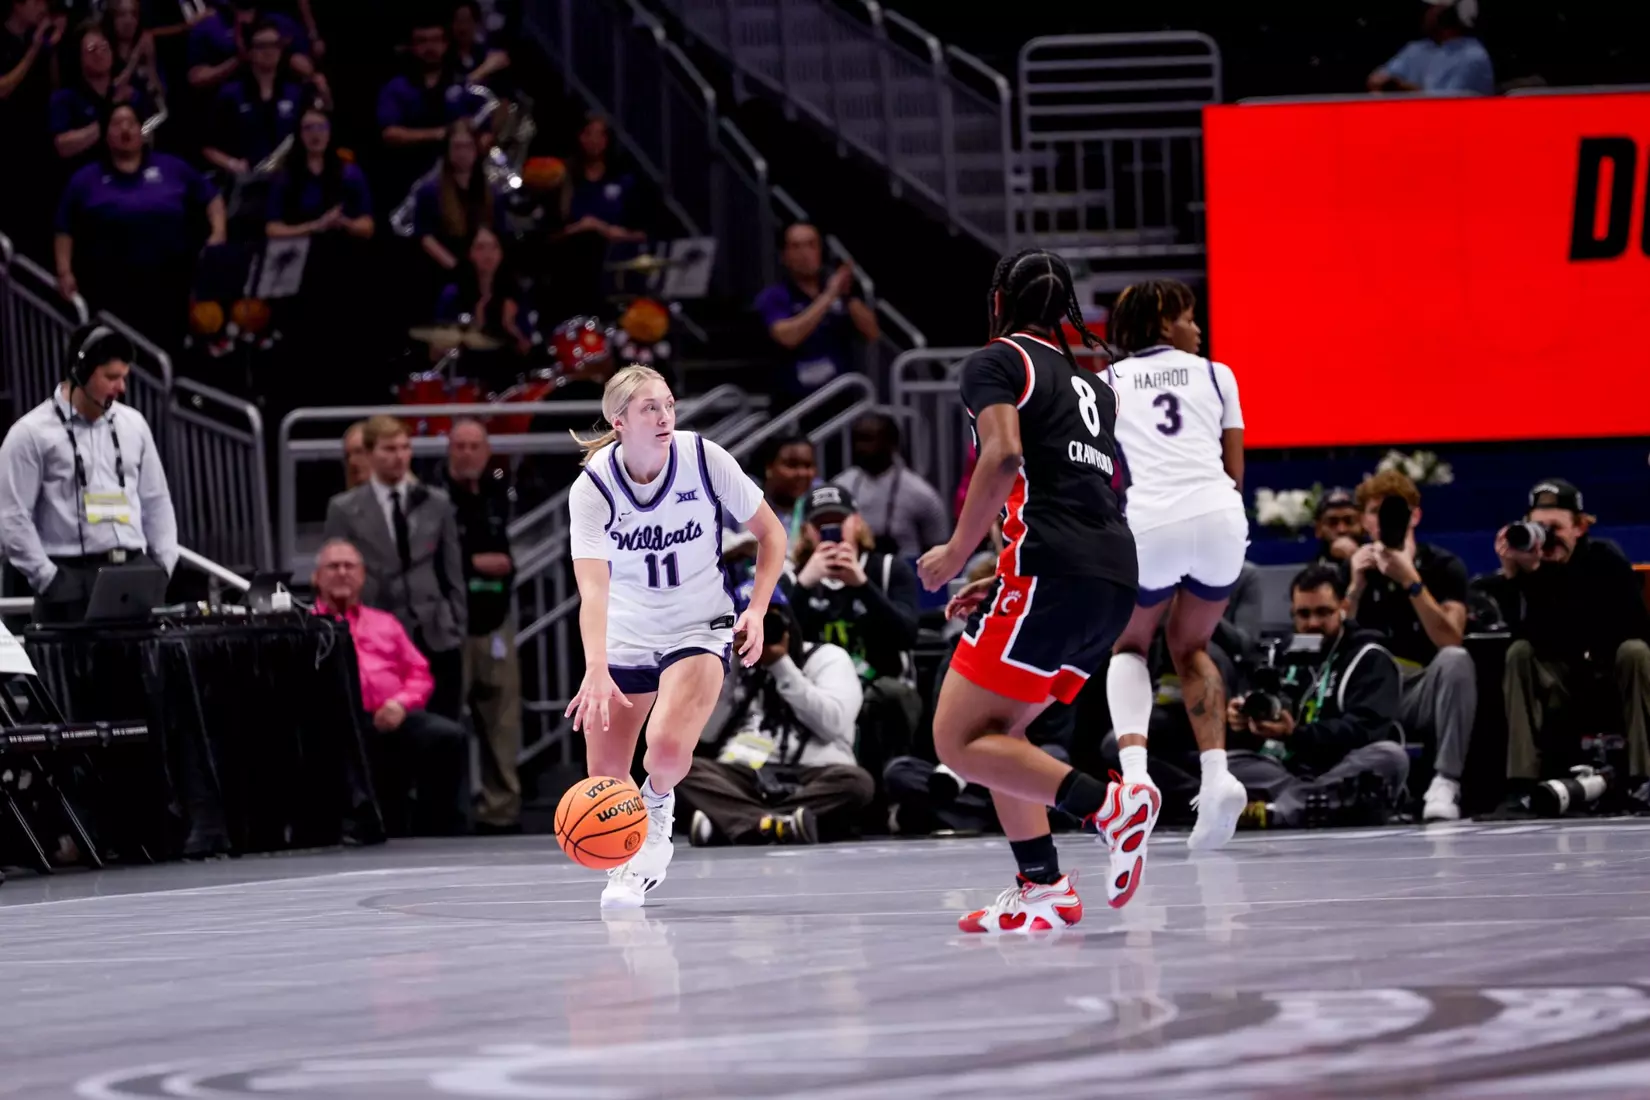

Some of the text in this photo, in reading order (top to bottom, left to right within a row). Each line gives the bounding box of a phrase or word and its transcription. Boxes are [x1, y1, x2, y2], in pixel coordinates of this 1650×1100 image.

[1569, 136, 1650, 263] D
[1070, 375, 1101, 438] 8
[1152, 392, 1183, 436] 3
[610, 516, 704, 551] Wildcats
[644, 551, 681, 589] 11
